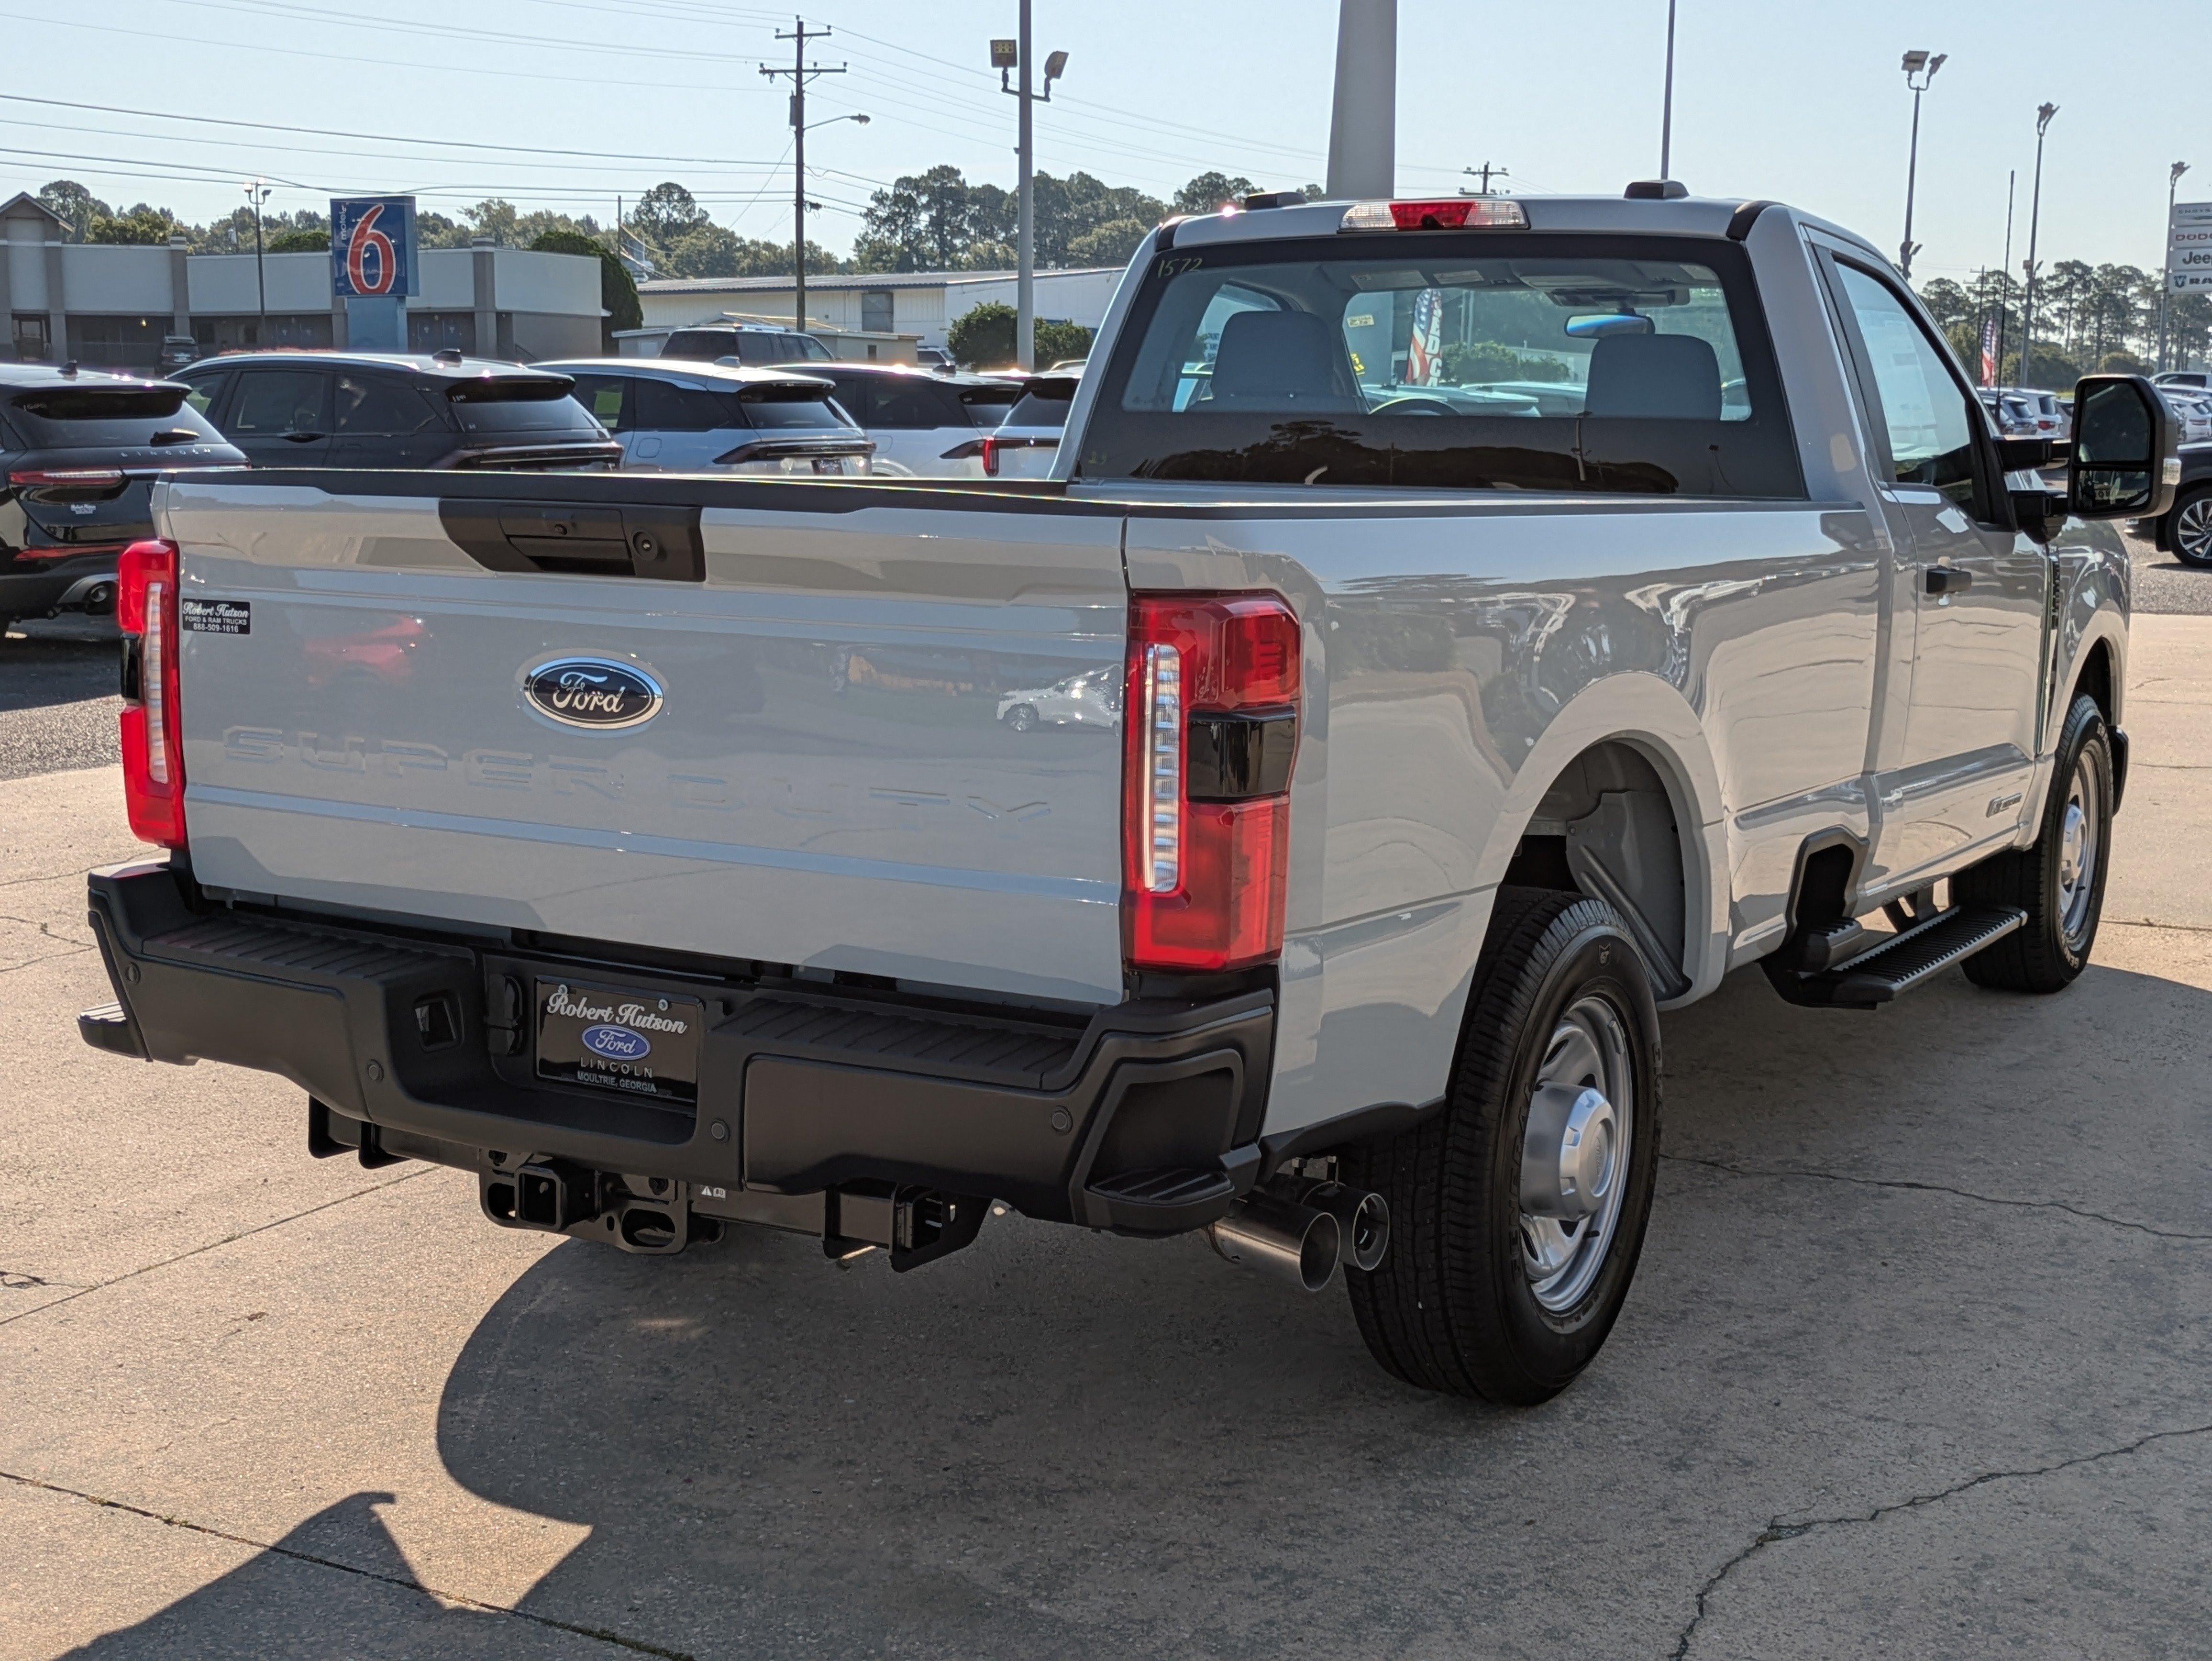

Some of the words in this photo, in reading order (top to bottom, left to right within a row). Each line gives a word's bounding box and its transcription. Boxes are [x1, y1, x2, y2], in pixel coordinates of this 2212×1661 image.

[347, 203, 397, 295] 6
[2182, 251, 2212, 266] Jee
[1157, 257, 1203, 278] 1572
[183, 602, 214, 616] Robert
[215, 604, 249, 617] Hutson
[552, 671, 626, 713] Ford
[547, 992, 614, 1022] Robert
[615, 1003, 688, 1034] Hutson
[595, 1029, 637, 1054] Ford
[580, 1056, 653, 1078] LINCOLN
[577, 1070, 618, 1087] MOULTRIE,
[619, 1078, 657, 1093] GEORGIA
